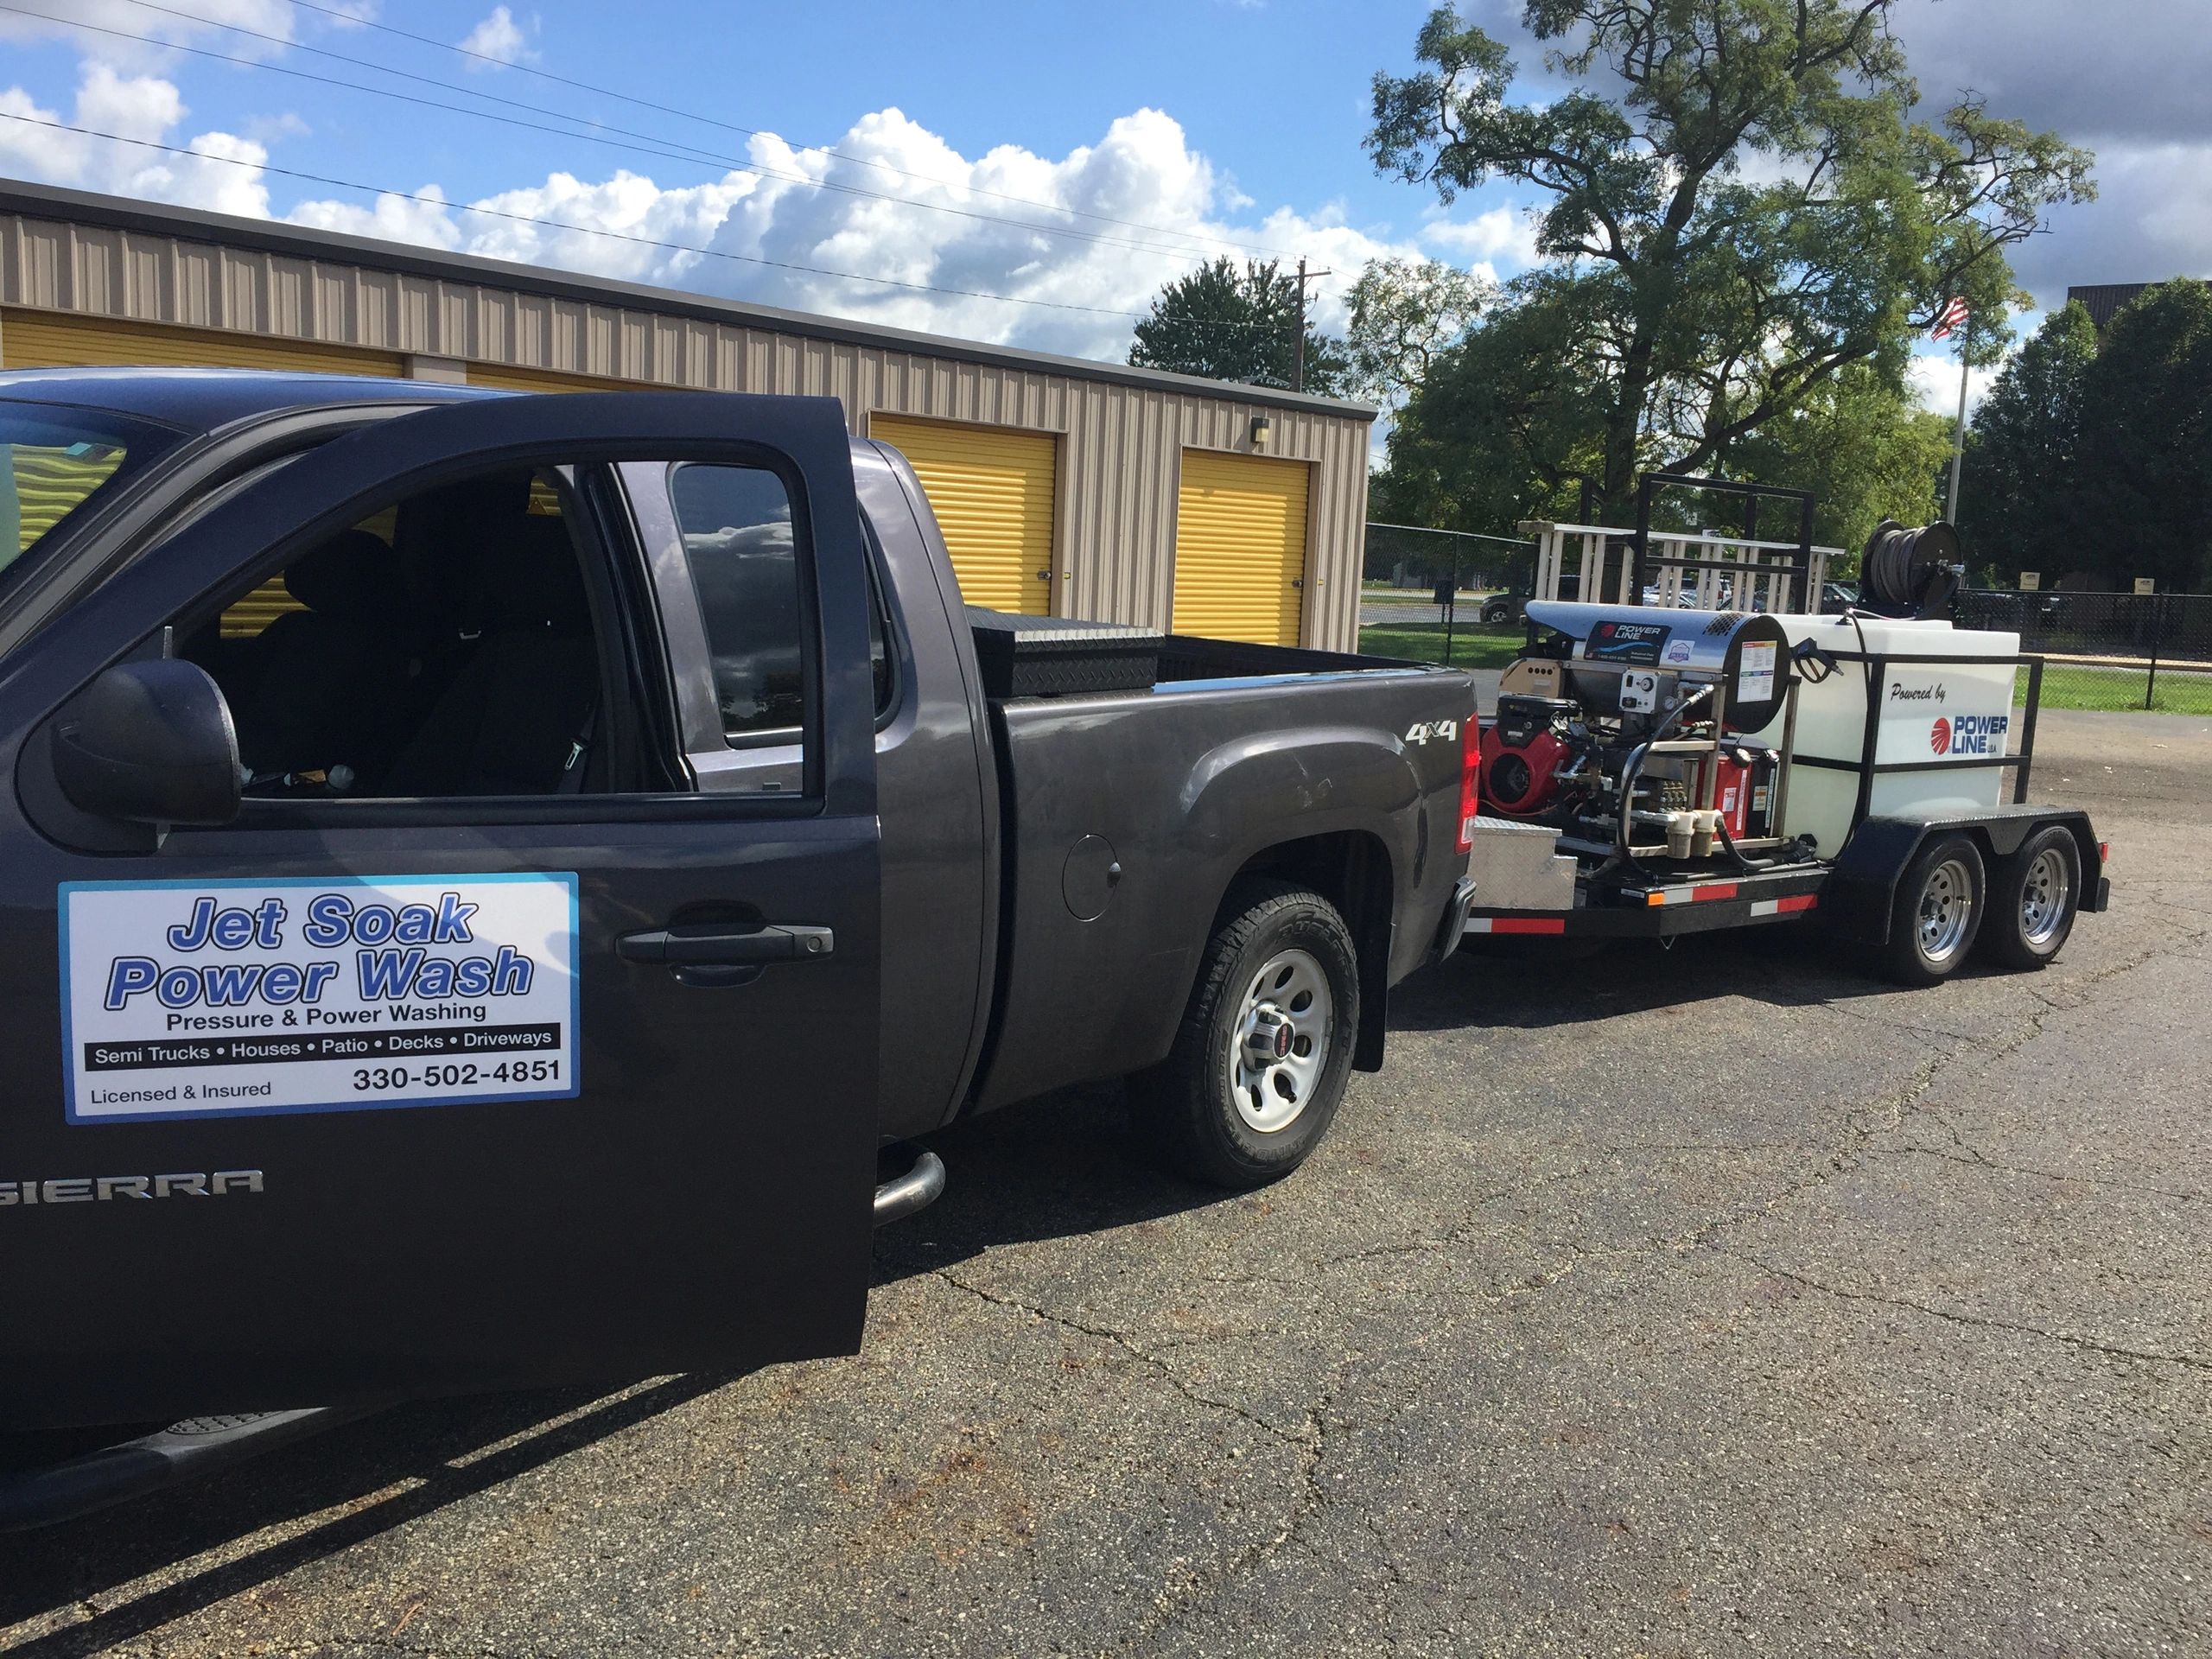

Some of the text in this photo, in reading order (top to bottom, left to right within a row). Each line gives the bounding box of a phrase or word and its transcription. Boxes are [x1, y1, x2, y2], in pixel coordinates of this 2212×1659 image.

[1614, 631, 1642, 639] LINE
[1618, 625, 1661, 634] POWER
[1891, 683, 1946, 703] Powered by
[1954, 715, 2008, 734] POWER
[1951, 735, 1987, 754] LINE
[167, 892, 479, 952] Jet Soak
[104, 945, 535, 1012] Power Wash
[167, 1003, 486, 1031] Pressure & Power Washing
[95, 1029, 552, 1064] Semi Trucks Houses Patio Decks Driveways
[353, 1060, 561, 1090] 330-502-4851
[91, 1082, 271, 1104] Licensed & Insured
